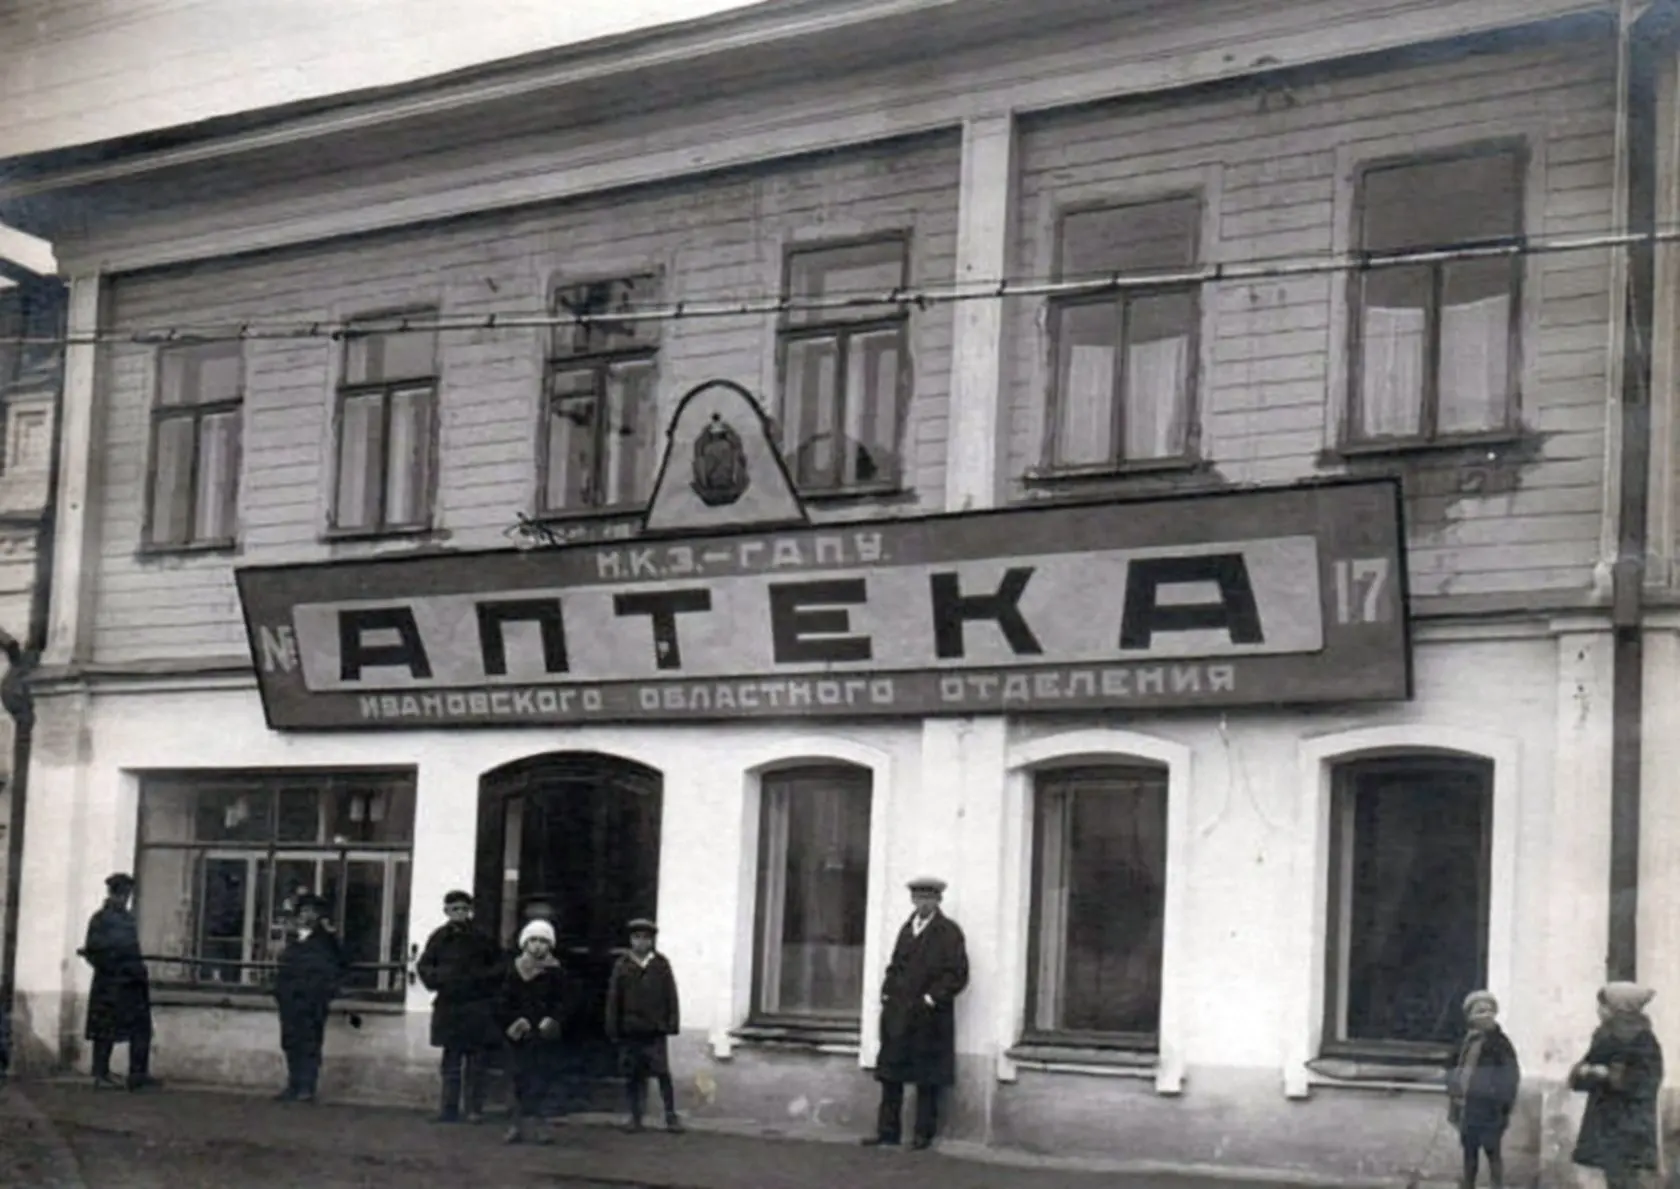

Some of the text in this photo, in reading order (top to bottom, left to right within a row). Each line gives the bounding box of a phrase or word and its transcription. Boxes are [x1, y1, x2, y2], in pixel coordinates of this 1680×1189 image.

[338, 552, 1264, 682] АПТЕКА
[1334, 557, 1389, 624] 17
[360, 664, 1236, 719] ИВАНОВСКОГО ОБЛАСТНОГО ОТДЕЛЕНИЯ
